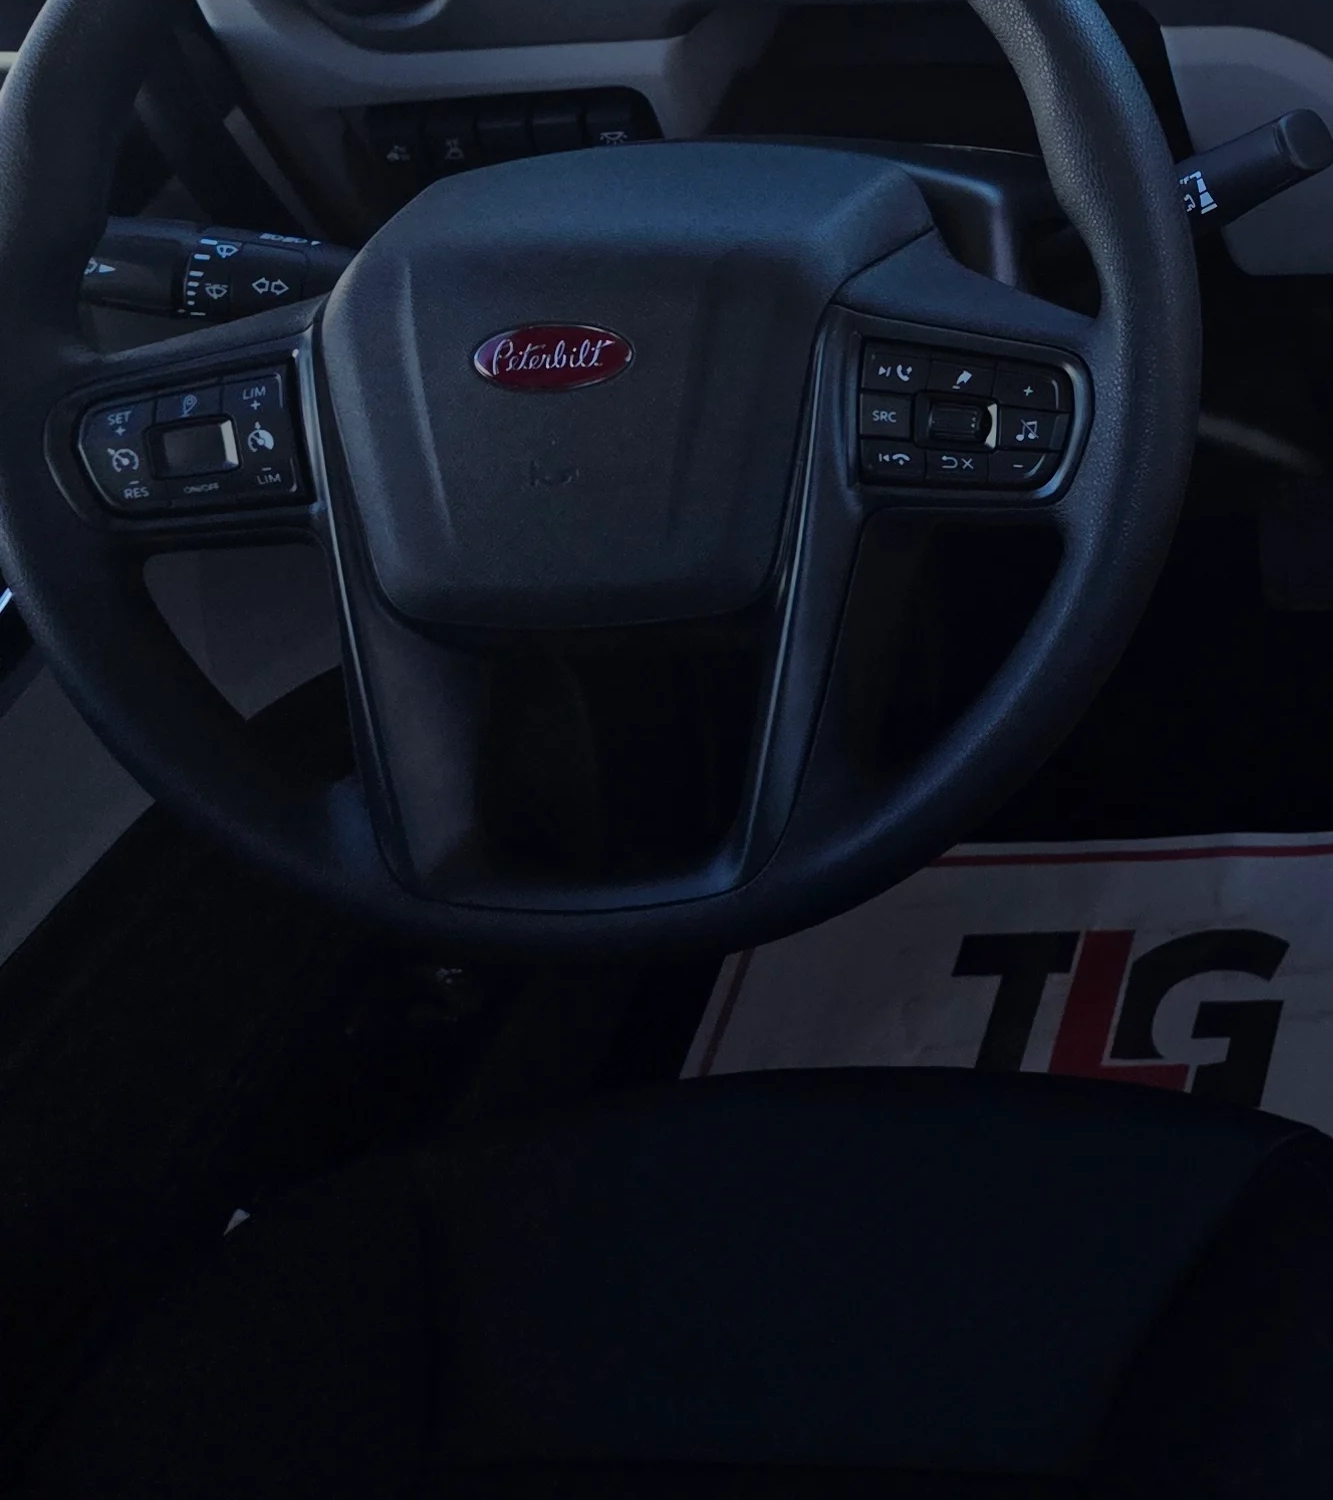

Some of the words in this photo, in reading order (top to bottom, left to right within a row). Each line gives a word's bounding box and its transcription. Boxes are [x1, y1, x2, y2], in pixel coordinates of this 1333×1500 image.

[493, 338, 616, 376] Peterbilt
[242, 385, 267, 401] LIM
[107, 409, 133, 426] SET
[872, 409, 897, 423] SRC
[256, 472, 282, 485] LIM
[123, 486, 150, 499] RES
[183, 481, 220, 494] ON/OFF
[950, 927, 1291, 1110] TLG
